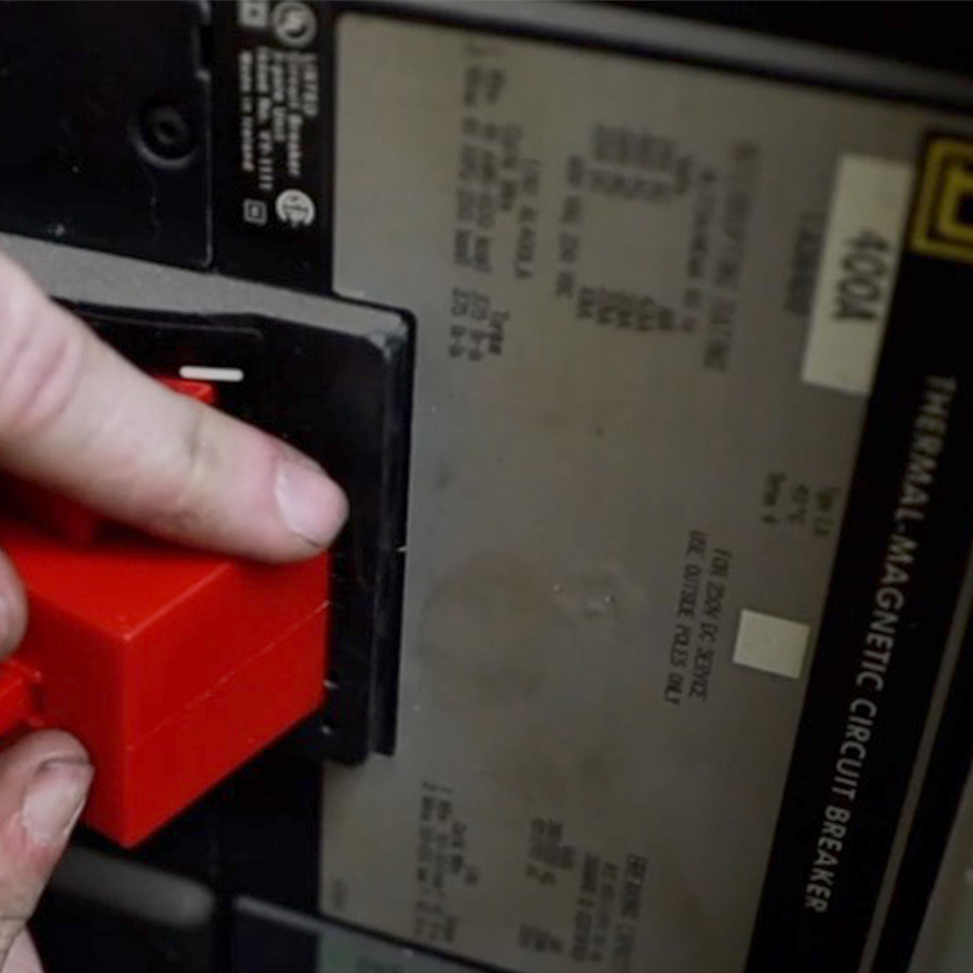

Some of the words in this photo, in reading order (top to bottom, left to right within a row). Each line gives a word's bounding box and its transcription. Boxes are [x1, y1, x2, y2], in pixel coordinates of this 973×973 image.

[288, 112, 303, 176] Breaker
[832, 227, 889, 320] 400A
[856, 375, 957, 692] THERMAL-MAGNETIC
[677, 563, 703, 620] OUTSIDE
[670, 622, 693, 669] POLES
[696, 621, 720, 643] DC
[663, 671, 685, 706] ONLY
[688, 646, 715, 702] SERVICE
[831, 696, 878, 801] CIRCUIT
[803, 804, 852, 913] BREAKER
